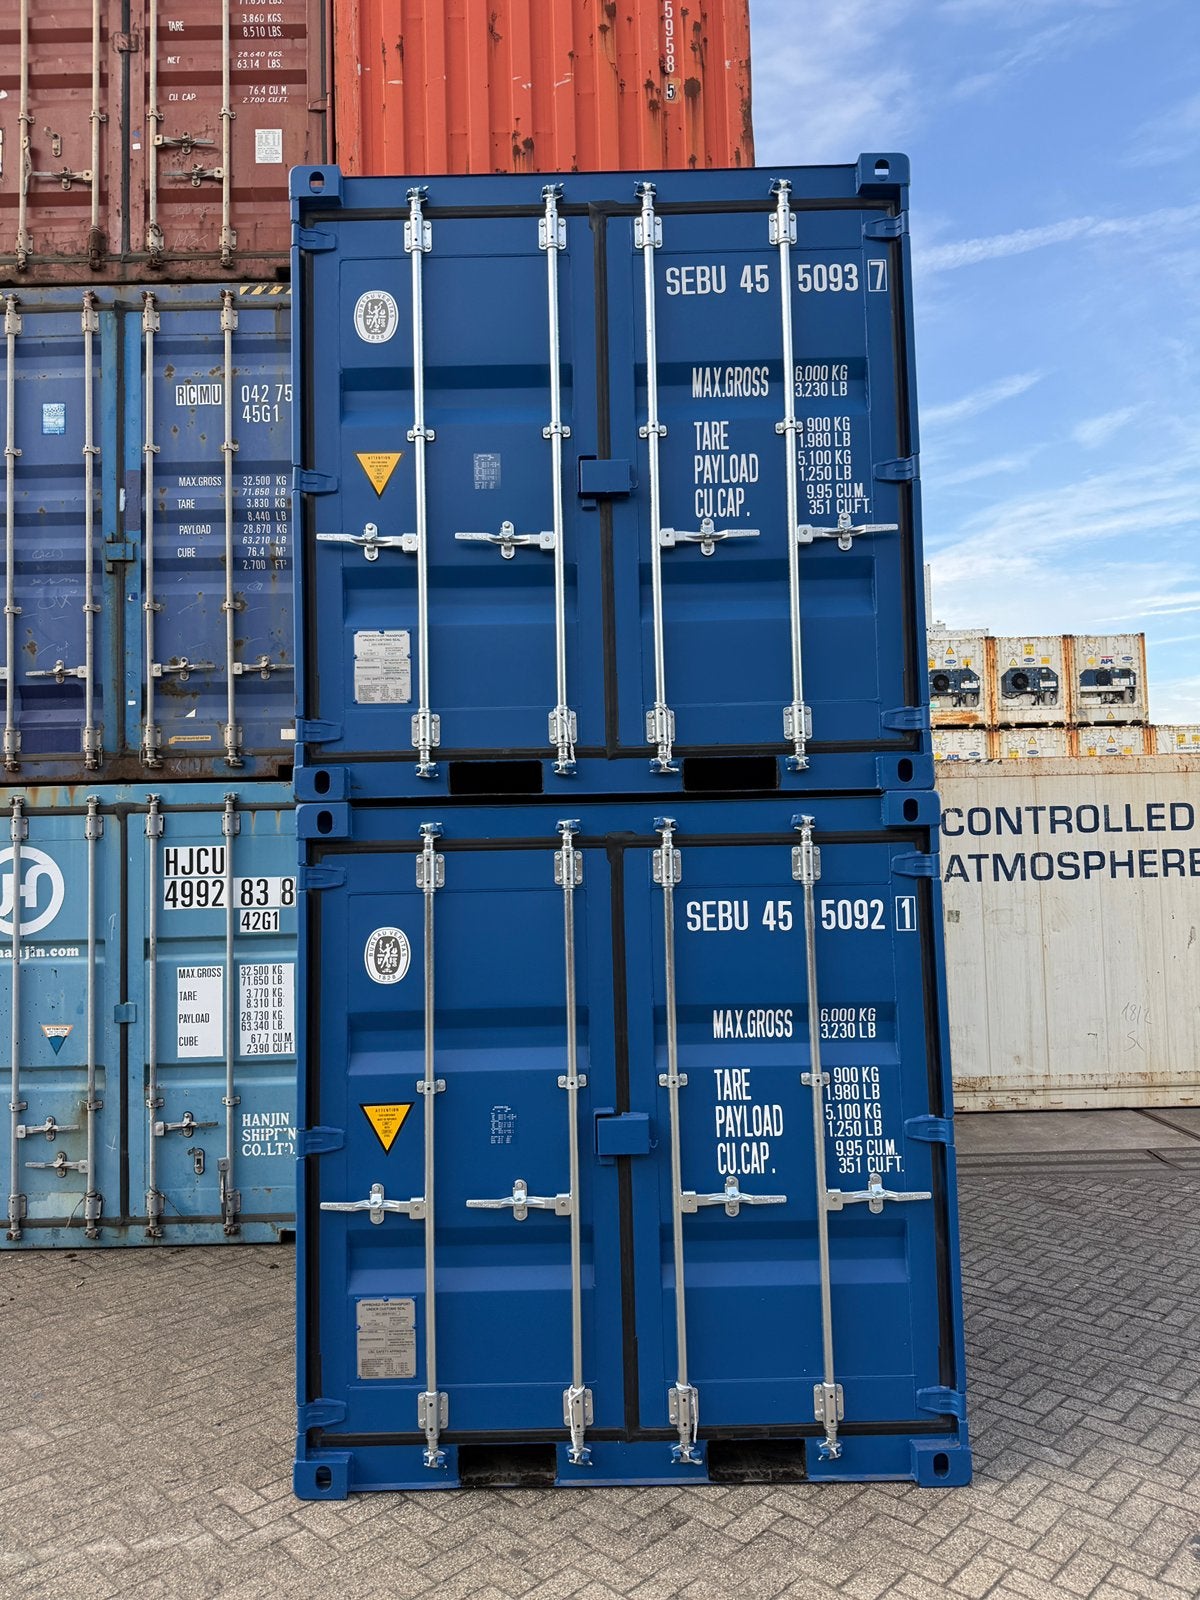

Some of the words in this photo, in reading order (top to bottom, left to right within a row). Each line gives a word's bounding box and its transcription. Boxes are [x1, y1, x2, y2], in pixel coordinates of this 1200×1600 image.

[168, 20, 184, 31] TARE
[242, 14, 265, 22] 3.860
[243, 26, 265, 37] 8.510
[167, 56, 180, 64] NET
[249, 86, 266, 95] 76.4
[666, 265, 726, 295] SEBU
[740, 264, 769, 293] 45
[798, 263, 858, 292] 5093
[869, 260, 886, 291] 7
[692, 367, 769, 398] MAX.GROSS
[832, 365, 848, 381] KG
[832, 382, 847, 396] LB
[177, 385, 222, 404] RCMU
[242, 385, 269, 402] 042
[242, 405, 279, 423] 45G1
[807, 417, 830, 432] 900
[834, 417, 850, 432] KG
[694, 421, 729, 450] TARE
[835, 432, 850, 447] LB
[835, 450, 851, 464] KG
[694, 454, 759, 484] PAYLOAD
[836, 466, 852, 480] LB
[179, 476, 222, 486] MAX.GROSS
[243, 476, 270, 486] 32.500
[276, 476, 287, 485] KG
[807, 484, 832, 499] 9.95
[178, 500, 195, 509] TARE
[246, 498, 269, 508] 3.830
[275, 498, 286, 507] KG
[809, 500, 830, 515] 351
[276, 511, 286, 521] LB
[179, 525, 211, 535] PAYLOAD
[277, 524, 287, 534] KG
[178, 548, 196, 557] CUBE
[247, 547, 265, 557] 76.4
[243, 560, 266, 570] 2.700
[940, 802, 1195, 836] CONTROLLED
[166, 848, 225, 876] HJCU
[944, 848, 1200, 882] ATMOSPHERE
[165, 880, 224, 908] 4992
[241, 879, 268, 906] 83
[282, 878, 294, 905] 8
[241, 912, 279, 931] 42G1
[686, 900, 749, 931] SEBU
[762, 900, 793, 931] 45
[821, 899, 886, 930] 5092
[899, 898, 913, 930] 1
[179, 968, 222, 979] MAX.GROSS
[241, 966, 268, 976] 32.500
[242, 976, 269, 986] 71.650
[179, 991, 197, 1001] TARE
[246, 988, 268, 998] 3.770
[246, 998, 269, 1008] 8.310
[179, 1013, 210, 1023] PAYLOAD
[241, 1011, 269, 1021] 28.730
[713, 1009, 793, 1039] MAX.GROSS
[859, 1008, 876, 1022] KG
[859, 1023, 876, 1038] LB
[179, 1037, 198, 1046] CUBE
[251, 1034, 268, 1043] 67.7
[247, 1044, 269, 1054] 2.390
[834, 1067, 858, 1083] 900
[862, 1067, 879, 1083] KG
[714, 1068, 752, 1100] TARE
[864, 1084, 880, 1099] LB
[864, 1103, 881, 1119] KG
[242, 1113, 290, 1127] HANJIN
[715, 1104, 783, 1138] PAYLOAD
[866, 1120, 882, 1136] LB
[836, 1140, 862, 1156] 9.95
[839, 1157, 861, 1174] 351
